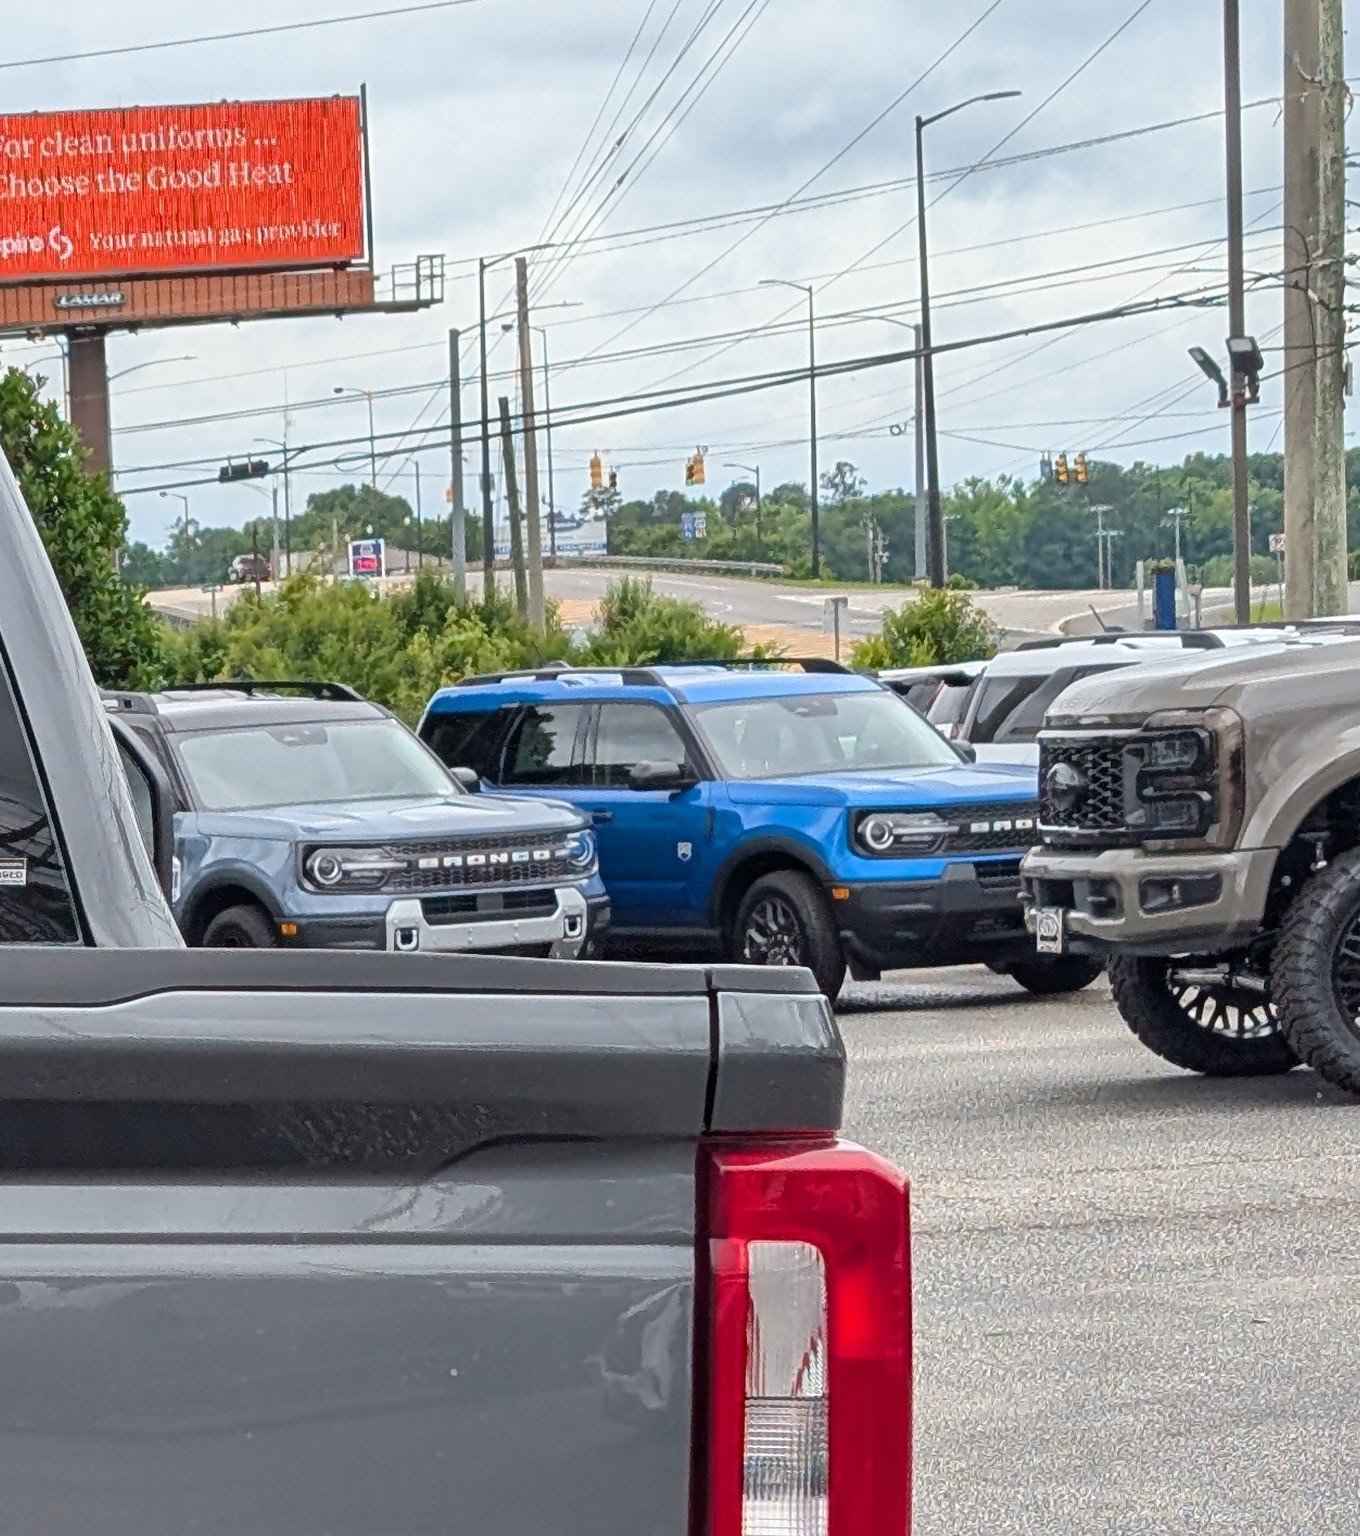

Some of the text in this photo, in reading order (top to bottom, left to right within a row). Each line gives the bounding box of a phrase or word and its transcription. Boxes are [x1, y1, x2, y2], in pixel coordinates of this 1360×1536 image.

[40, 130, 115, 158] clean
[121, 124, 248, 153] uniforms
[96, 167, 141, 193] the
[146, 161, 223, 191] Good
[229, 160, 294, 187] Heat
[89, 230, 135, 252] Your
[141, 227, 214, 249] natural
[256, 218, 343, 246] provider
[970, 819, 1039, 833] BRO
[418, 849, 551, 869] BRONCO
